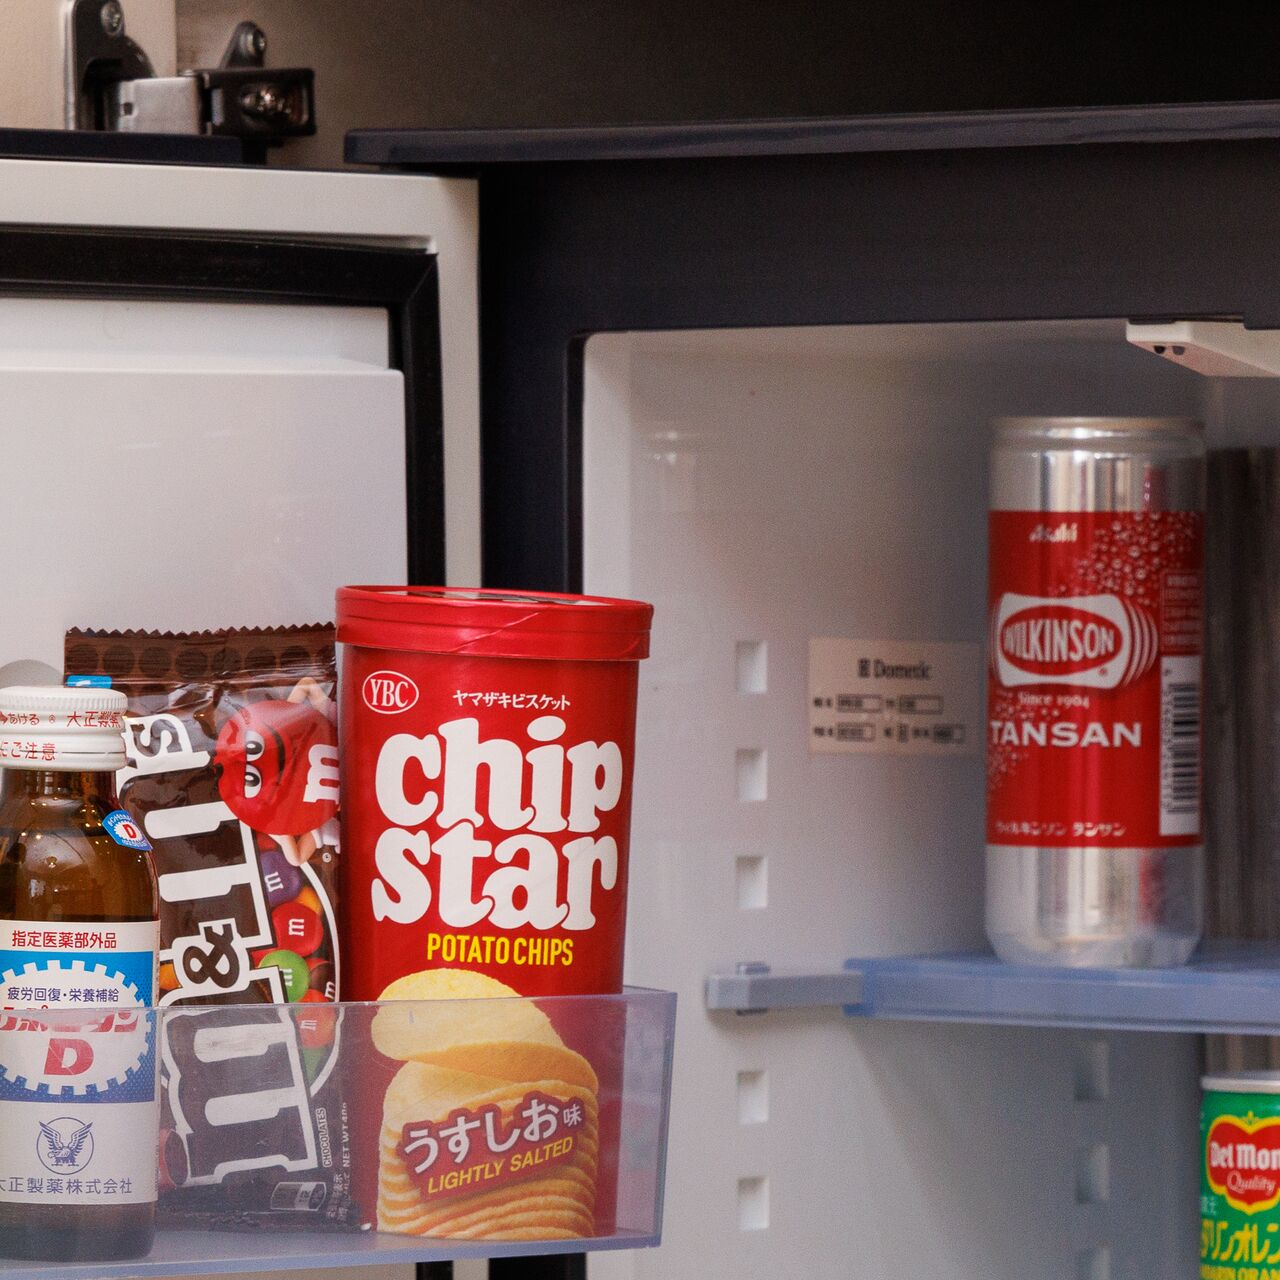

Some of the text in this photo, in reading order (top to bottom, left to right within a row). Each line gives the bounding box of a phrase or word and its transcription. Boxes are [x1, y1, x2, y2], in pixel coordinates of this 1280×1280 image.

[1029, 522, 1078, 543] Asahi
[1004, 618, 1115, 662] WILKINSON
[371, 678, 409, 700] YBC
[453, 689, 571, 711] ヤマザキビスケット
[7, 712, 40, 726] あける
[990, 720, 1141, 747] TANSAN
[303, 743, 340, 803] m
[375, 715, 623, 833] chip
[371, 821, 619, 931] star
[12, 931, 117, 949] 指定医薬部外品
[288, 917, 305, 937] m
[427, 932, 574, 966] POTATO CHIPS
[7, 986, 119, 1003] 疲労回復・栄養補給
[43, 1037, 94, 1075] D
[316, 1107, 332, 1168] CHOCOLATES
[404, 1098, 583, 1174] うすしお味
[428, 1136, 574, 1195] LIGHTLY SALTED
[1210, 1141, 1234, 1169] Del
